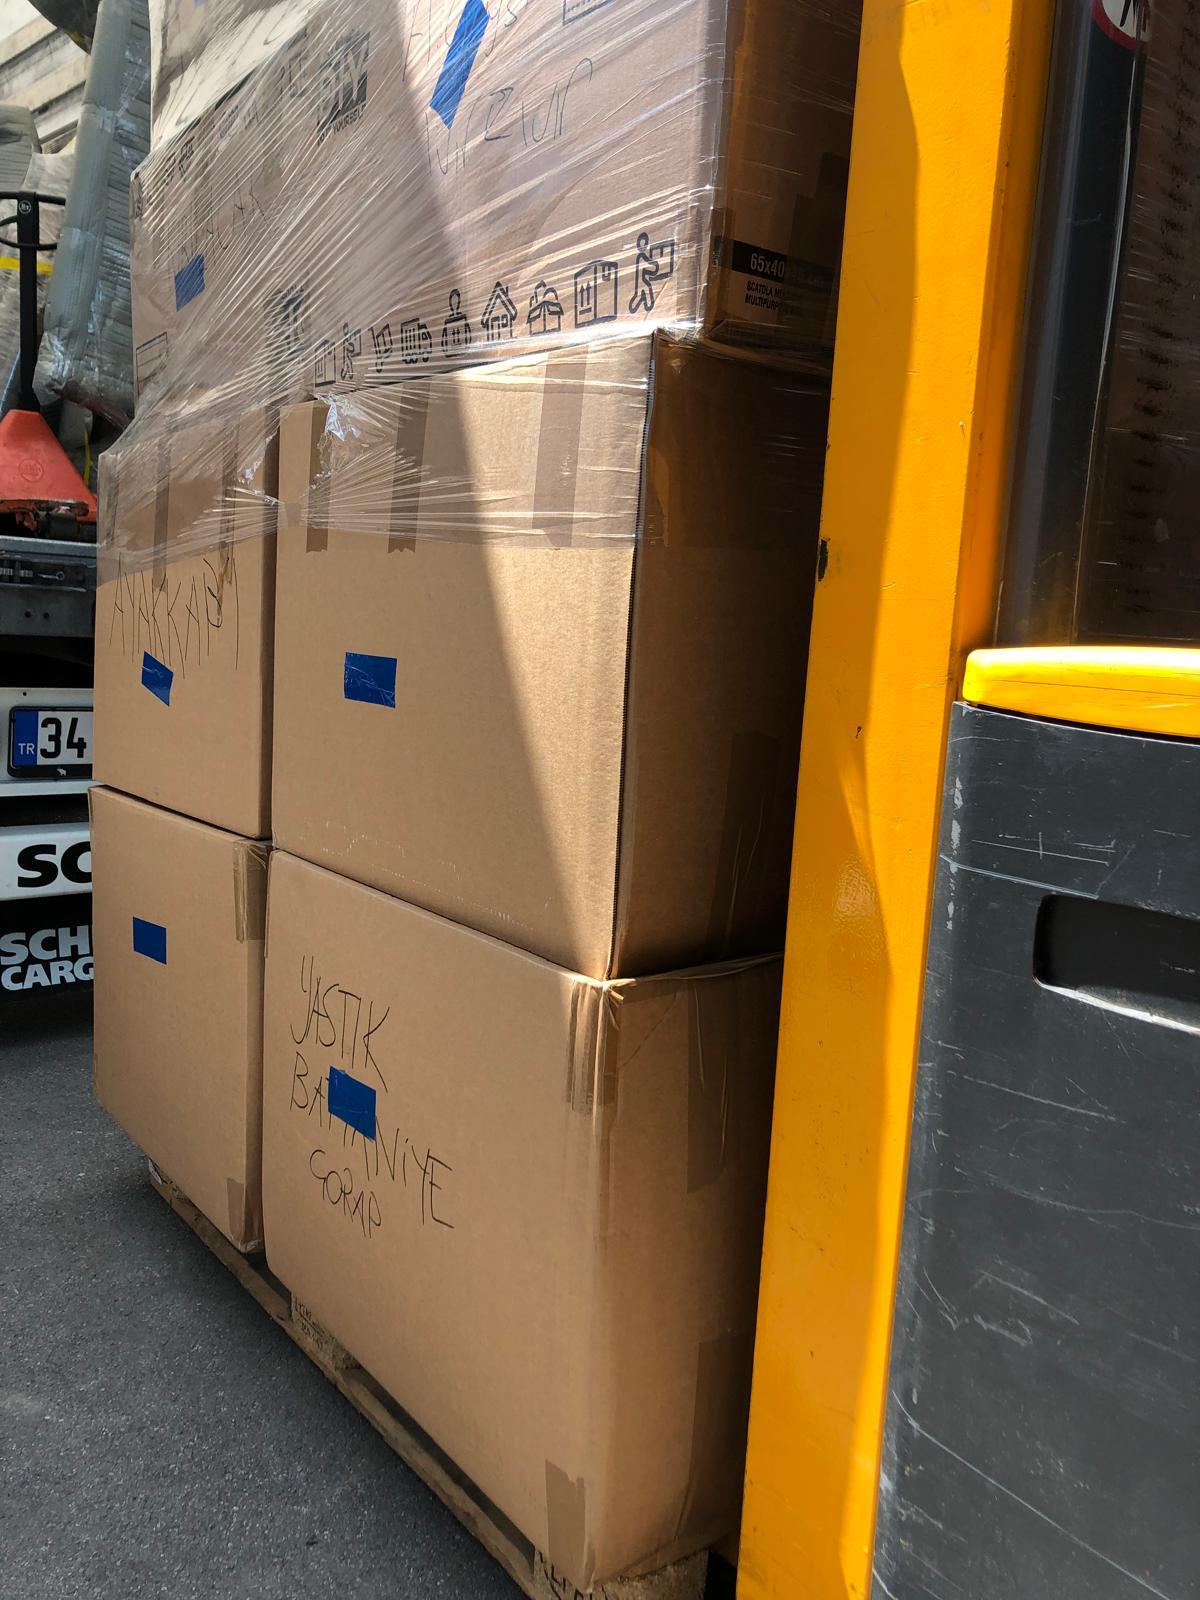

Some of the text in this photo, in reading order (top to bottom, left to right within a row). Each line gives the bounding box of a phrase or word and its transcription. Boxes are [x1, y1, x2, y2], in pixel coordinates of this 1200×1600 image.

[750, 252, 785, 279] 65x40
[18, 717, 87, 760] TR 34
[0, 924, 91, 966] SCH
[1, 956, 94, 991] CARG
